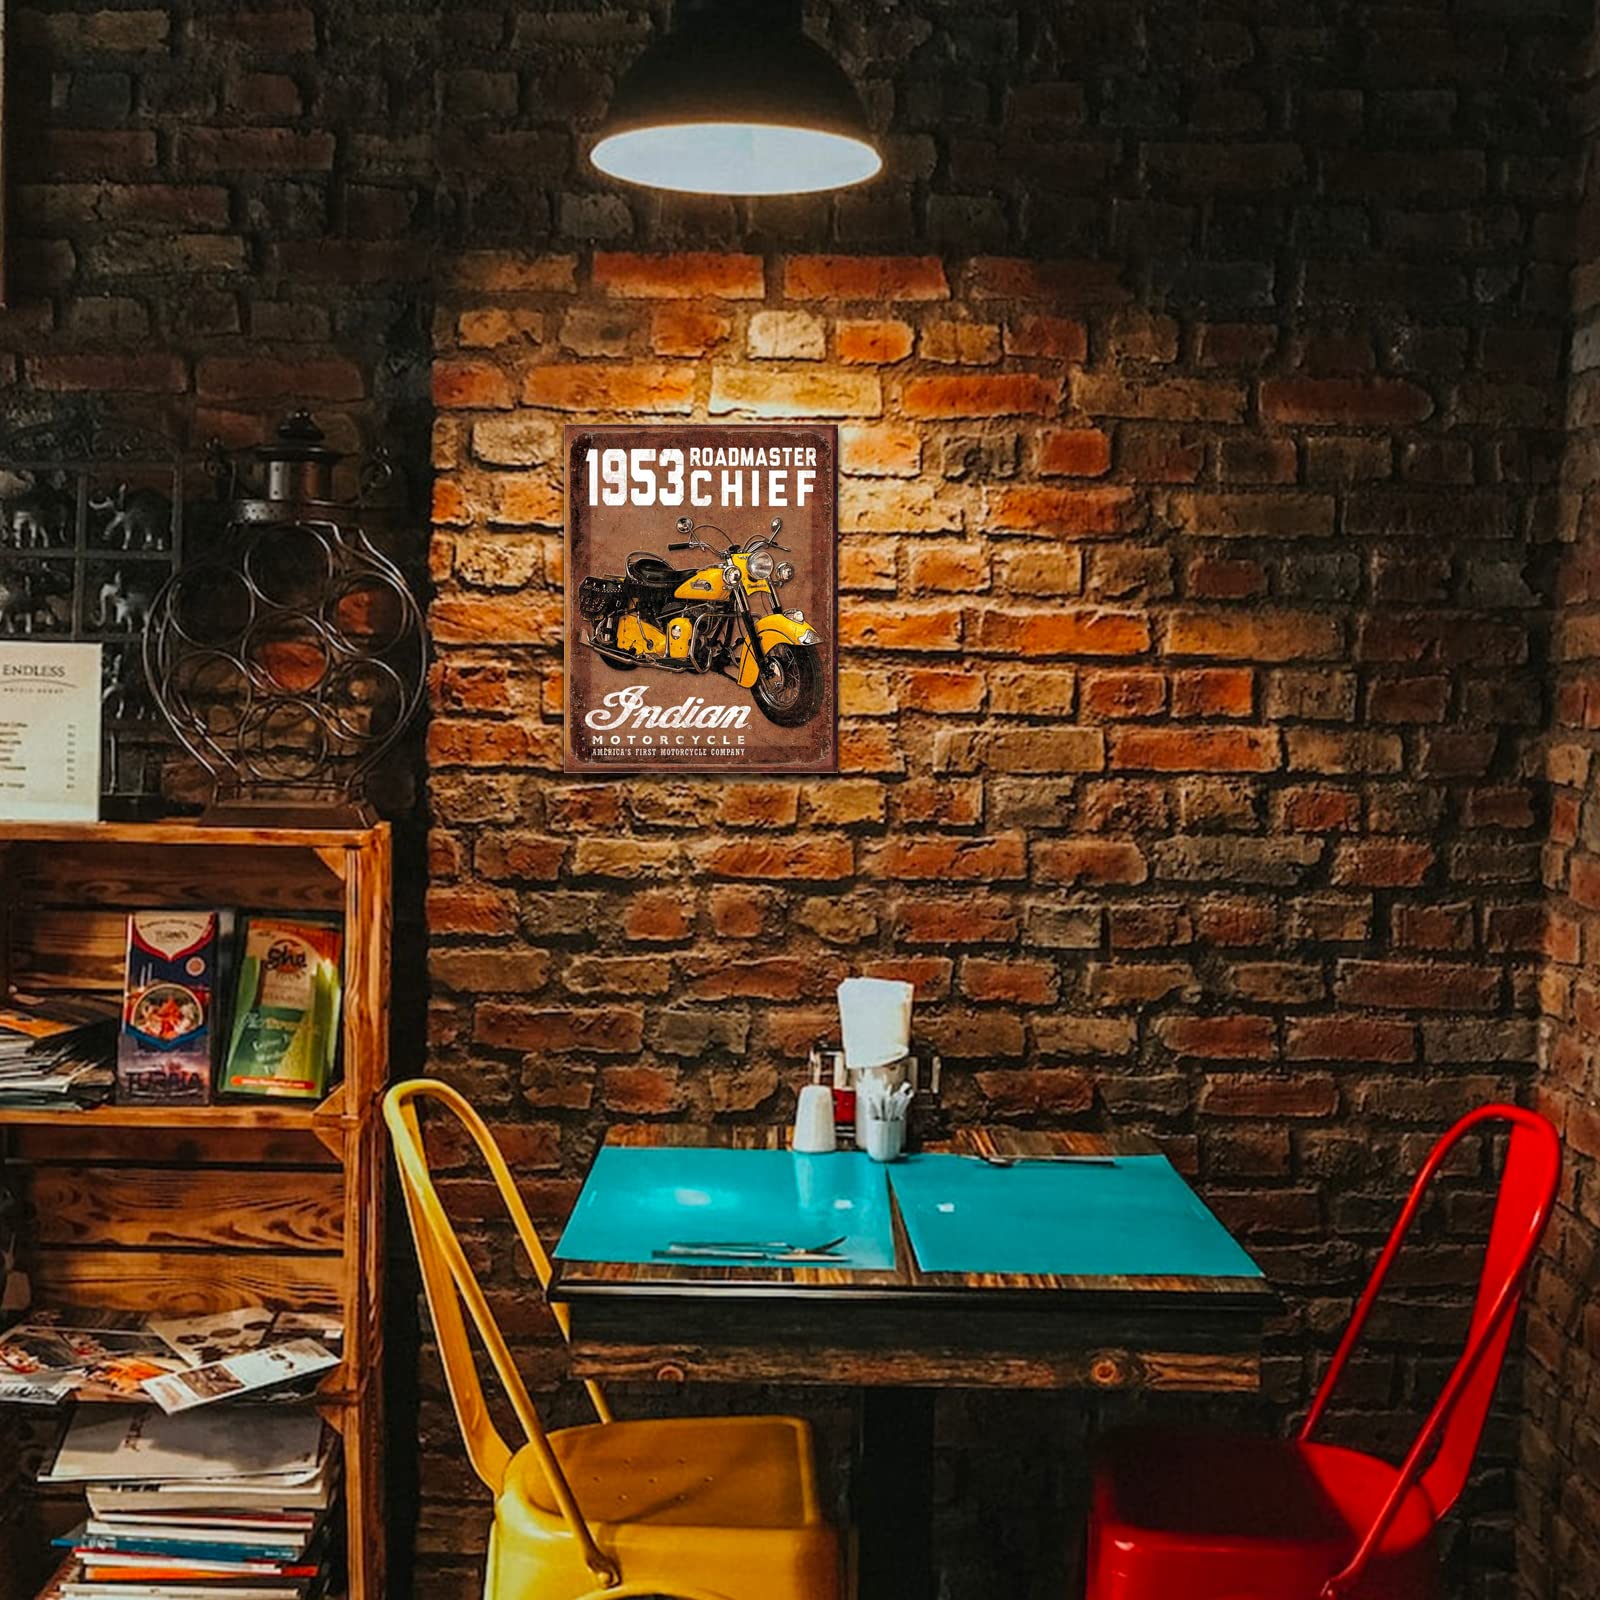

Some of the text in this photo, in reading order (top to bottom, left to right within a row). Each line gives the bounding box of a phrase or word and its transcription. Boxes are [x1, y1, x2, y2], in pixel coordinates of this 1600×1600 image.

[690, 447, 817, 467] ROADMASTER
[585, 447, 685, 507] 1953
[690, 470, 817, 507] CHIEF
[3, 663, 66, 678] ENDLESS
[585, 686, 752, 731] Indian
[592, 735, 745, 745] MOTORCYCLE
[592, 748, 745, 756] AMERICA'S FIRST MOTORCYCLE COMPANY
